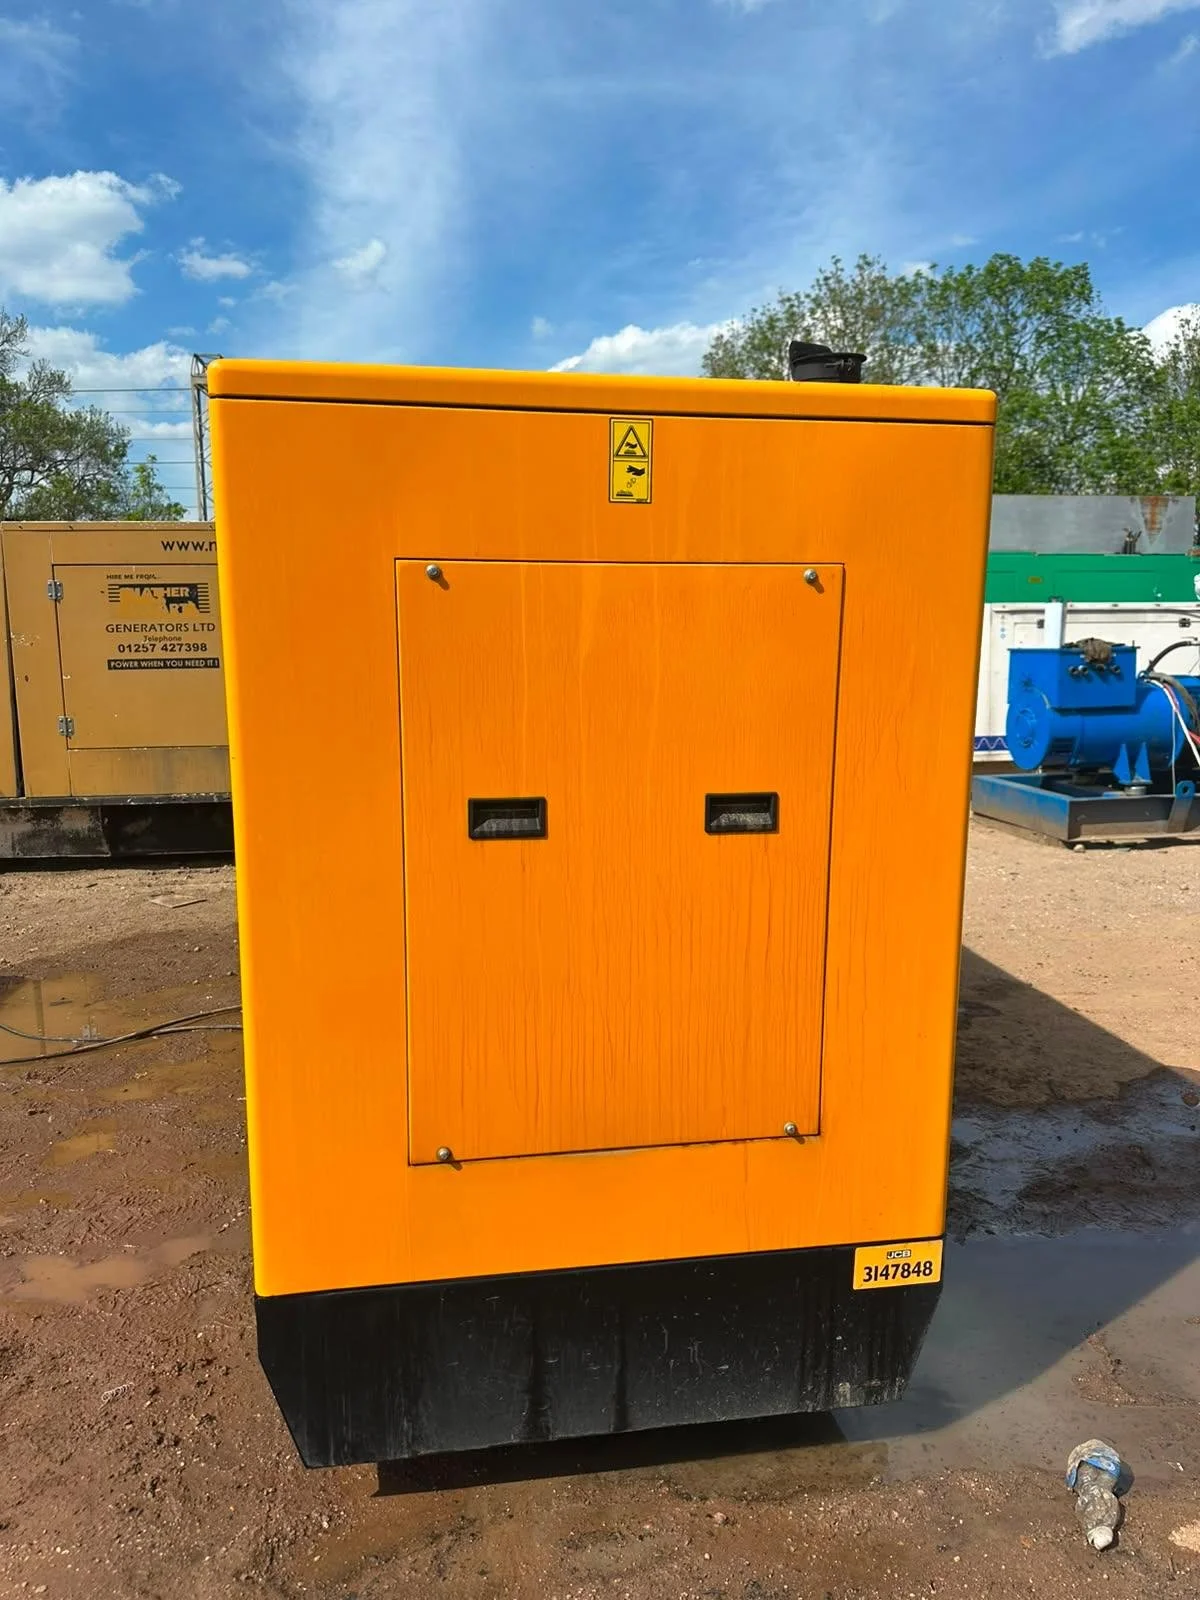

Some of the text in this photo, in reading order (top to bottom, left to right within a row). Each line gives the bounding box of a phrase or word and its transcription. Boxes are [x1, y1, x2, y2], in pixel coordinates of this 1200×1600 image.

[105, 622, 216, 634] GENERATORS LTD
[143, 634, 183, 643] Telephone
[117, 642, 208, 653] 01257 427398
[110, 660, 139, 669] POWER
[140, 660, 165, 668] WHEN
[166, 659, 184, 667] YOU
[185, 659, 206, 667] NEED
[887, 1250, 911, 1259] JCB
[863, 1260, 933, 1283] 3147848
